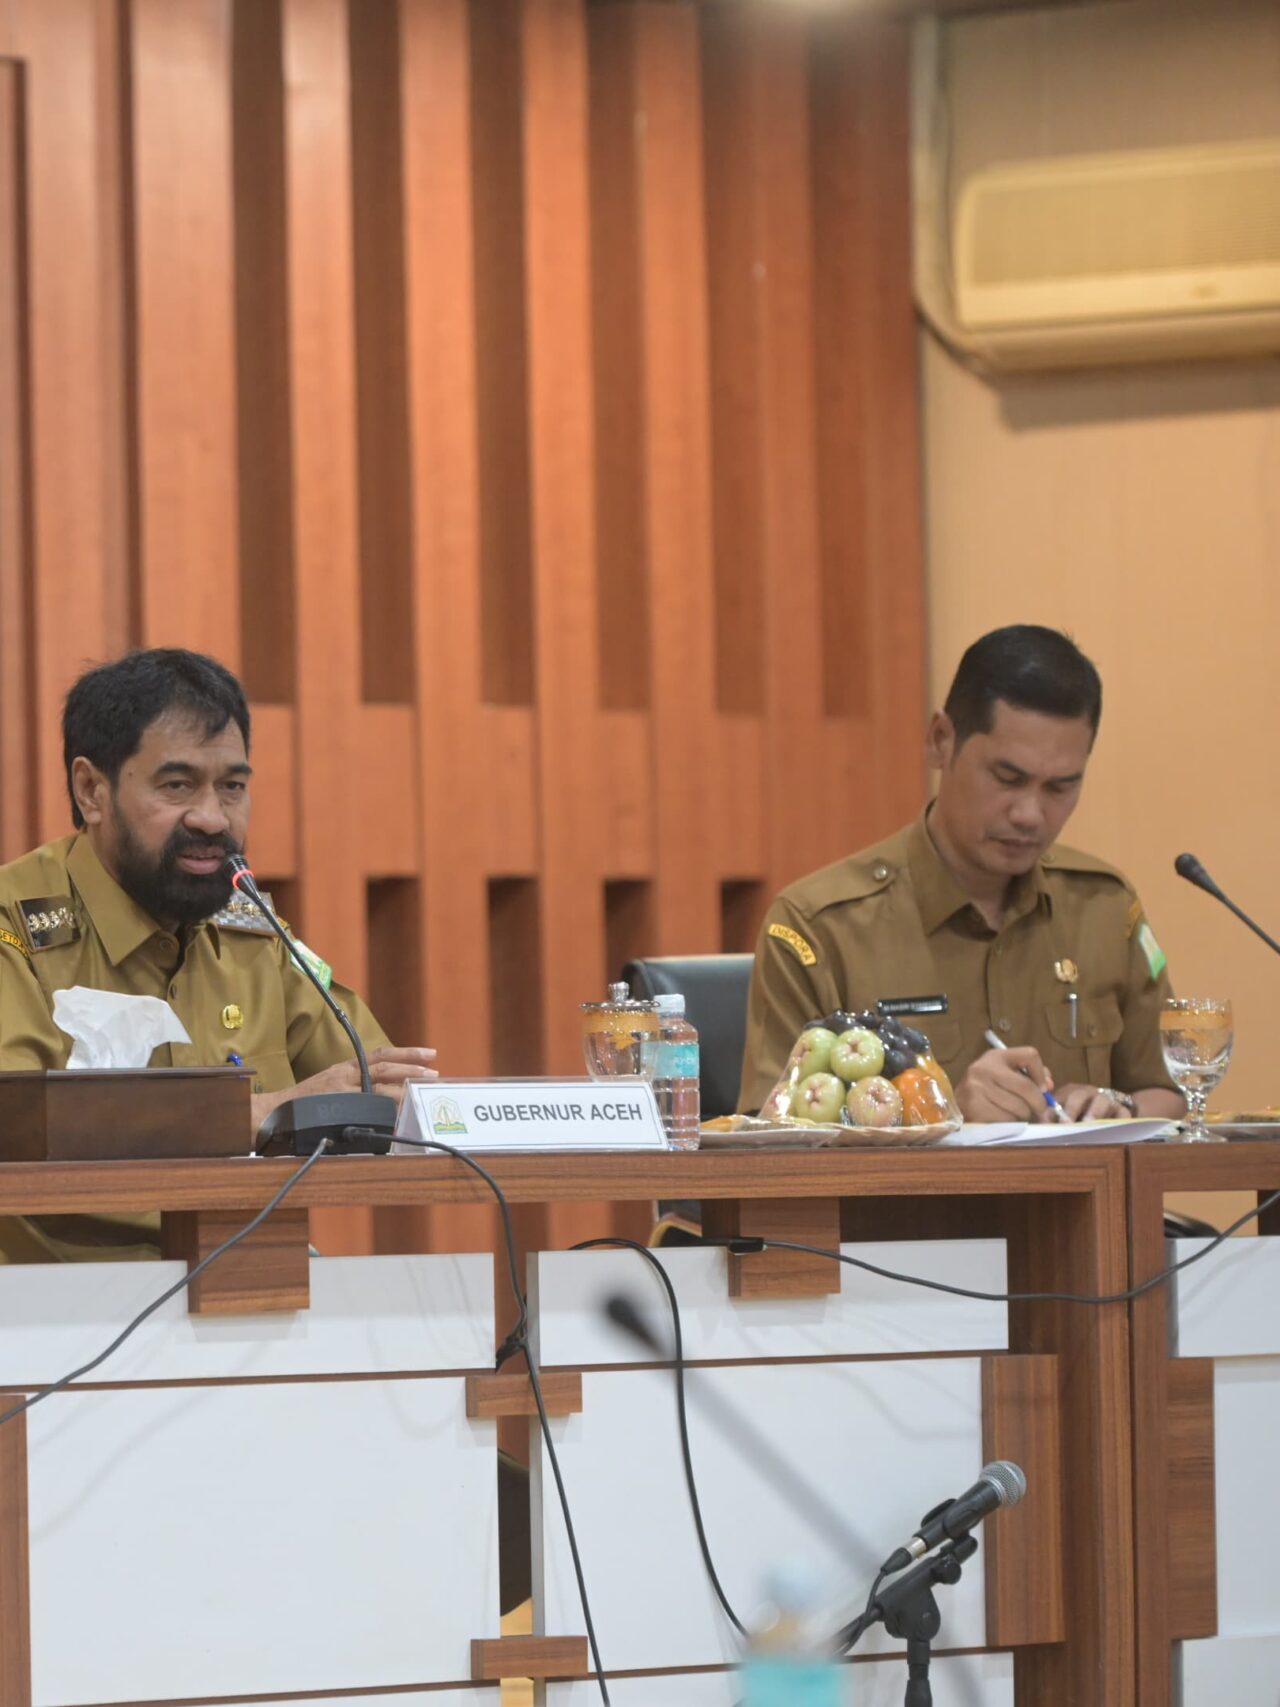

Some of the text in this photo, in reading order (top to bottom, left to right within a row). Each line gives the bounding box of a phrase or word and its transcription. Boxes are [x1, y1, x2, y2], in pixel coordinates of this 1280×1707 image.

[771, 926, 813, 961] DISPORA
[473, 1103, 643, 1122] GUBERNUR ACEH
